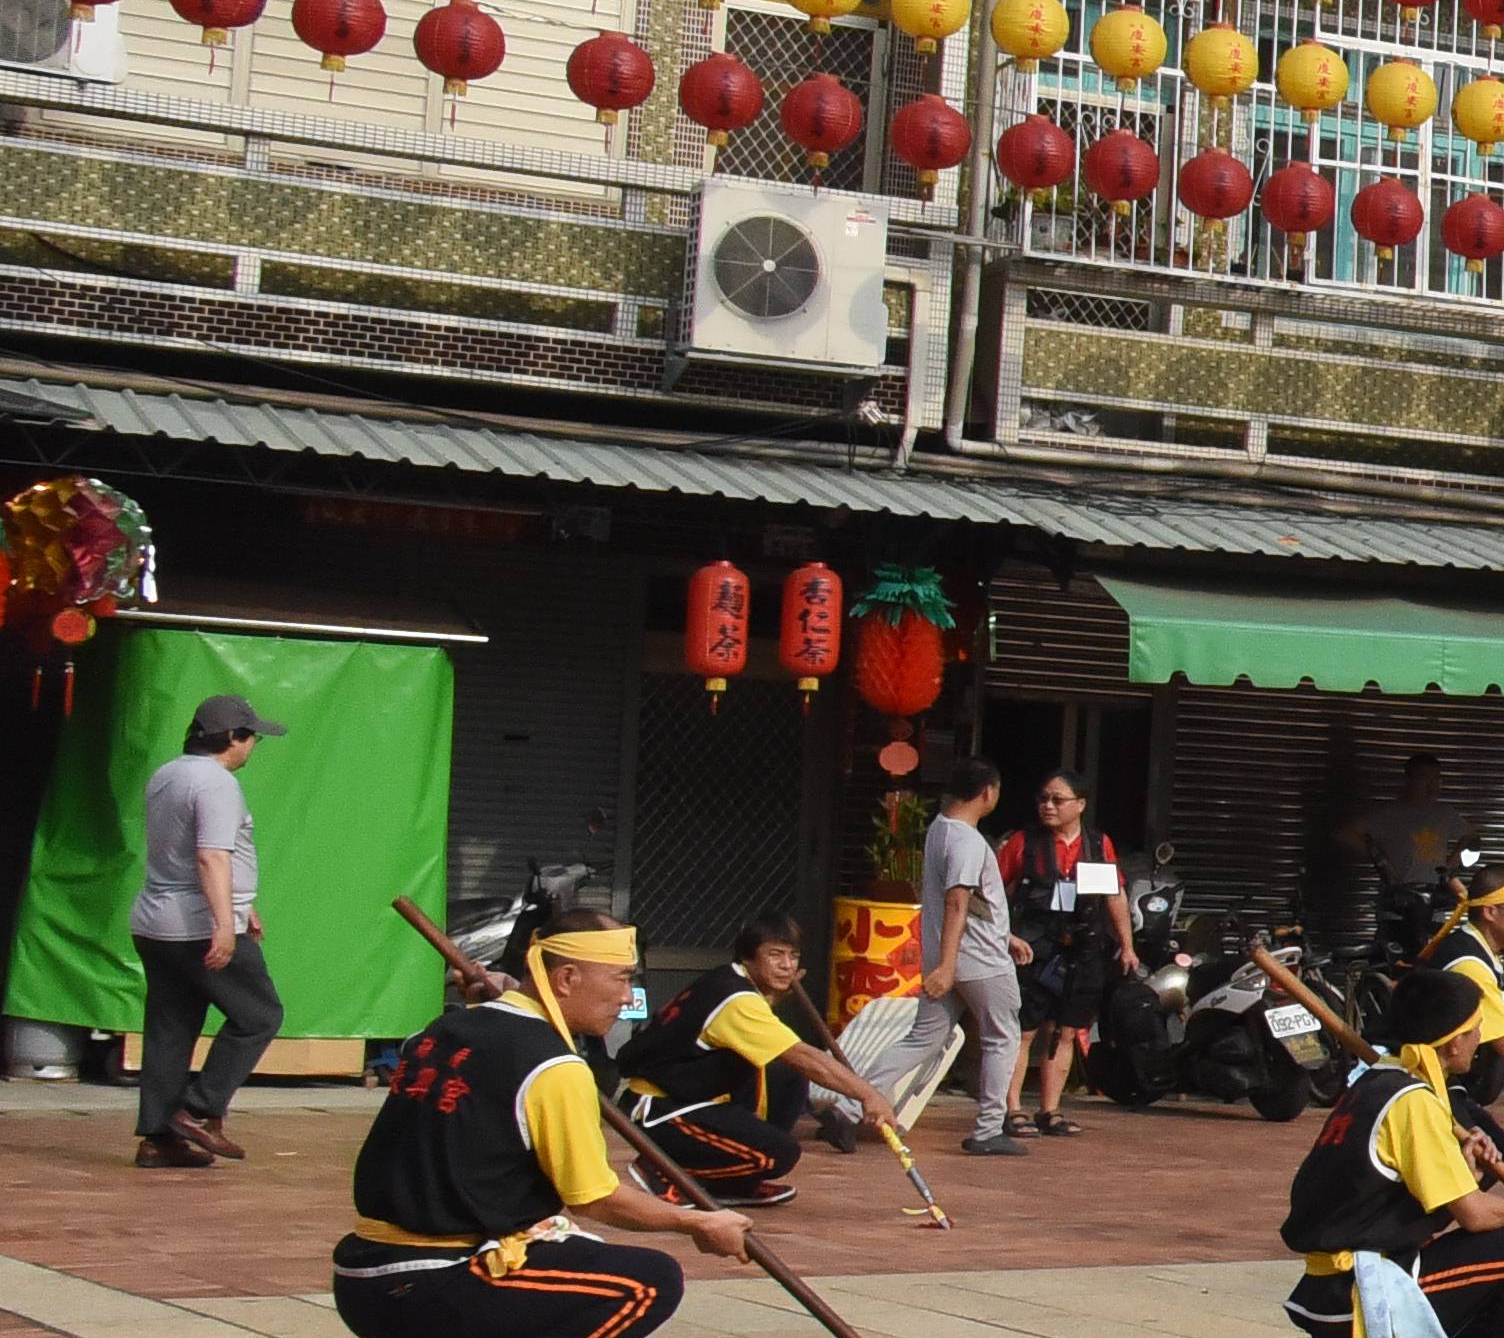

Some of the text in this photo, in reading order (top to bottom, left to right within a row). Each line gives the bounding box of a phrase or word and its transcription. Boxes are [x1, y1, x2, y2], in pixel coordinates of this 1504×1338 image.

[710, 579, 743, 661] 麵茶
[795, 578, 832, 665] 杏仁茶
